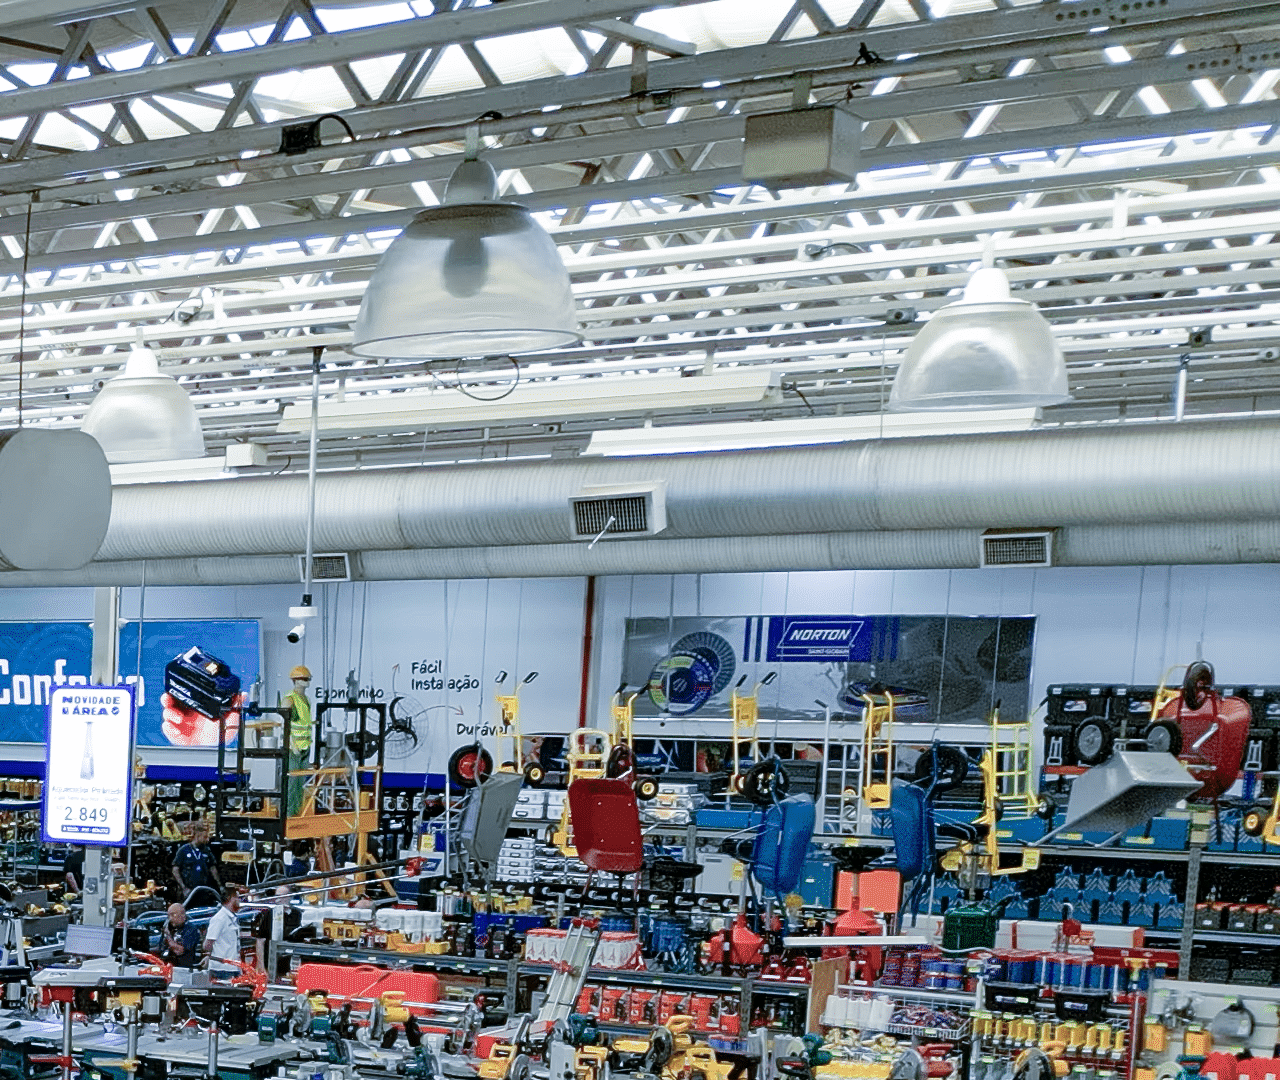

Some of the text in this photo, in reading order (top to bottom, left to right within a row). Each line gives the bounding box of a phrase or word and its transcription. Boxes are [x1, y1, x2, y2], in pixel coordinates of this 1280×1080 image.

[789, 629, 851, 641] NORTON
[411, 660, 442, 674] Fácil
[411, 675, 480, 693] Instaação
[62, 695, 121, 705] NOVIDADE
